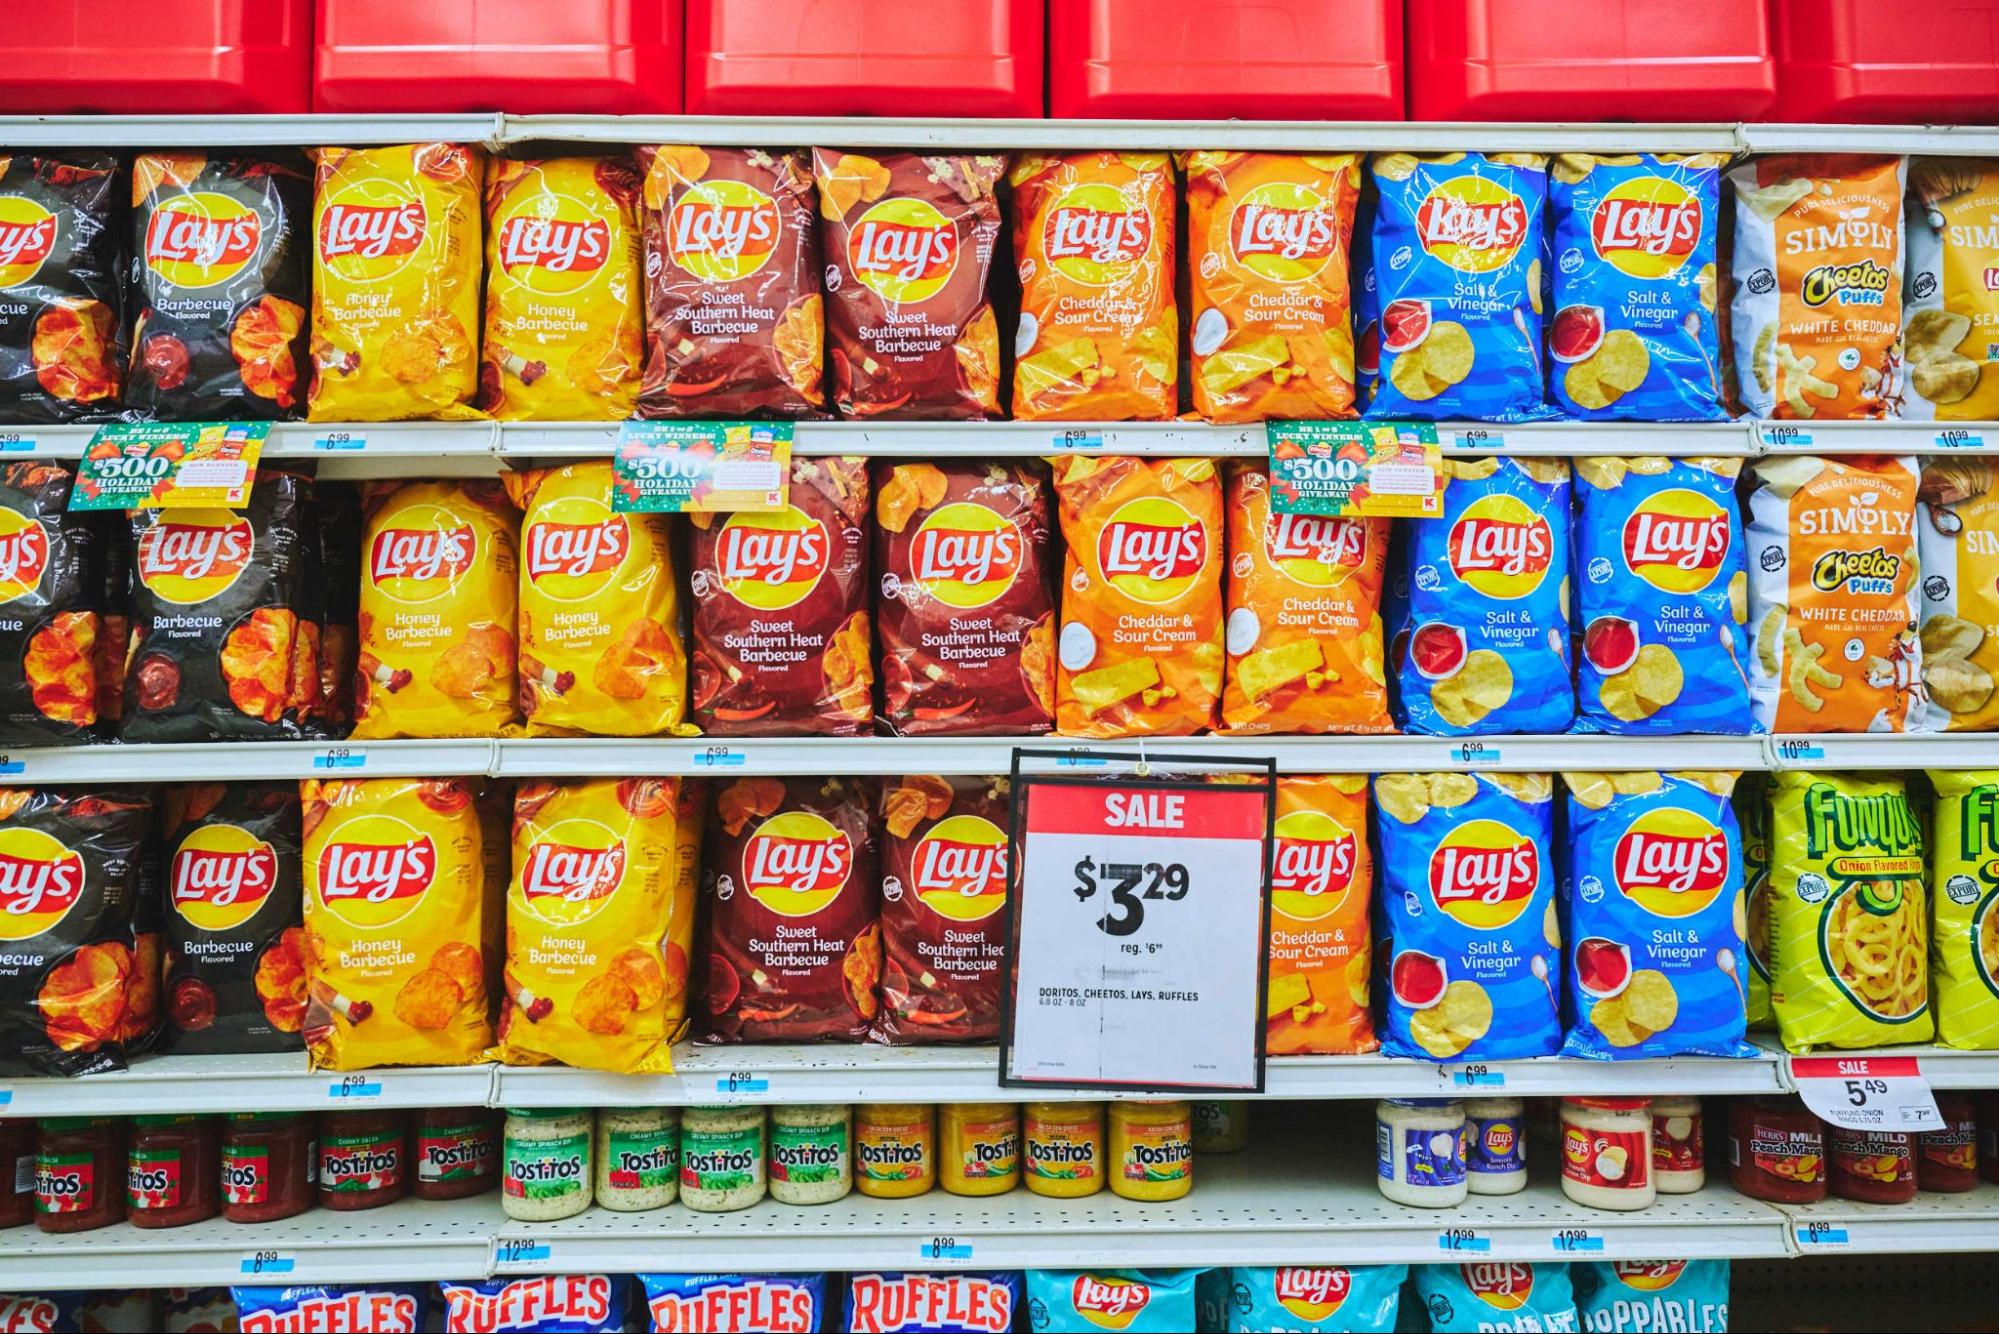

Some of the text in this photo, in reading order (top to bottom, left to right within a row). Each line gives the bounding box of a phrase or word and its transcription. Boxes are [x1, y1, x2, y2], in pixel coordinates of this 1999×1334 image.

[325, 204, 420, 258] Lay's
[1603, 200, 1697, 255] Lay's
[506, 218, 605, 272] Lay's
[1785, 222, 1893, 255] SIMPLY
[1803, 259, 1890, 307] Cheetos
[702, 292, 745, 305] Sweet
[1249, 293, 1312, 308] Cheddar
[1627, 290, 1658, 304] Salt
[1838, 289, 1884, 306] Puffs
[157, 298, 231, 312] Barbecue
[527, 303, 576, 319] Honey
[335, 306, 401, 321] Barbecue
[676, 305, 775, 321] Southern Heat
[1244, 309, 1280, 322] Sour
[1621, 306, 1678, 320] Vinegar
[517, 317, 588, 332] Barbecue
[692, 320, 758, 335] Barbecue
[859, 324, 958, 340] Southern Heat
[1790, 319, 1897, 335] WHITE CHEDDAR
[875, 339, 942, 353] Barbecue
[93, 456, 169, 478] $500
[628, 457, 702, 478] $500
[1283, 458, 1357, 480] $500
[95, 477, 162, 487] HOLIDAY
[633, 479, 699, 489] HOLIDAY
[1291, 480, 1356, 491] HOLIDAY
[1800, 507, 1912, 536] SIMPLY
[1273, 514, 1363, 564] Lay's
[1632, 513, 1727, 570] Lay's
[532, 518, 622, 577] Lay's
[1107, 523, 1201, 581] Lay's
[1458, 520, 1546, 575] Lay's
[725, 527, 821, 586] Lay's
[920, 527, 1015, 586] Lay's
[1813, 547, 1900, 593] Cheetos
[1849, 579, 1894, 593] Puffs
[1283, 598, 1345, 613] Cheddar
[1660, 605, 1690, 619] Salt
[153, 614, 222, 629] Barbecue
[395, 613, 440, 628] Honey
[553, 612, 599, 627] Honey
[1118, 615, 1180, 628] Cheddar
[1278, 613, 1359, 627] Sour Cream
[1486, 611, 1518, 624] Salt
[1800, 608, 1906, 622] WHITE CHEDDAR
[750, 620, 794, 633] Sweet
[950, 618, 992, 631] Sweet
[1654, 620, 1711, 636] Vinegar
[168, 630, 201, 638] Flavored
[385, 626, 453, 641] Barbecue
[545, 624, 611, 642] Barbecue
[922, 631, 1021, 648] Southern Heat
[1113, 629, 1196, 643] Sour Cream
[1480, 625, 1539, 640] Vinegar
[724, 633, 823, 648] Southern Heat
[740, 648, 808, 663] Barbecue
[940, 646, 1007, 661] Barbecue
[1104, 793, 1185, 829] SALE
[751, 836, 845, 892] Lay's
[1623, 830, 1724, 893] Lay's
[1839, 859, 1908, 872] Onion Flavored
[176, 848, 269, 906] Lay's
[325, 839, 427, 902] Lay's
[1439, 842, 1532, 905] Lay's
[1947, 883, 1980, 898] EXPORT
[776, 926, 817, 938] Sweet
[944, 930, 985, 943] Sweet
[1271, 930, 1332, 945] Cheddar
[1652, 929, 1683, 944] Salt
[184, 941, 254, 955] Barbecue
[351, 939, 401, 955] Honey
[541, 936, 586, 953] Honey
[749, 939, 845, 952] Southern Heat
[918, 942, 979, 956] Southern
[1121, 943, 1142, 955] reg.
[1305, 944, 1348, 958] Cream
[1468, 941, 1499, 955] Salt
[201, 955, 235, 963] Flavored
[341, 950, 416, 968] Barbecue
[529, 949, 597, 966] Barbecue
[765, 953, 829, 966] Barbecue
[1647, 945, 1707, 961] Vinegar
[934, 957, 997, 970] Barbecue
[1461, 956, 1521, 972] Vinegar
[1158, 991, 1199, 1002] RUFFLES
[1838, 1061, 1869, 1074] SALE
[1488, 1130, 1513, 1148] Lay's
[1868, 1132, 1908, 1143] MILD
[1751, 1140, 1789, 1155] Peach
[1868, 1143, 1909, 1158] Mango
[1280, 1267, 1345, 1305] Lay's
[1077, 1274, 1148, 1316] Lay's
[443, 1275, 611, 1333] RUFFLES
[651, 1281, 811, 1333] RUFFLES
[852, 1275, 1011, 1333] RUFFLES
[241, 1292, 417, 1333] RUFFLES
